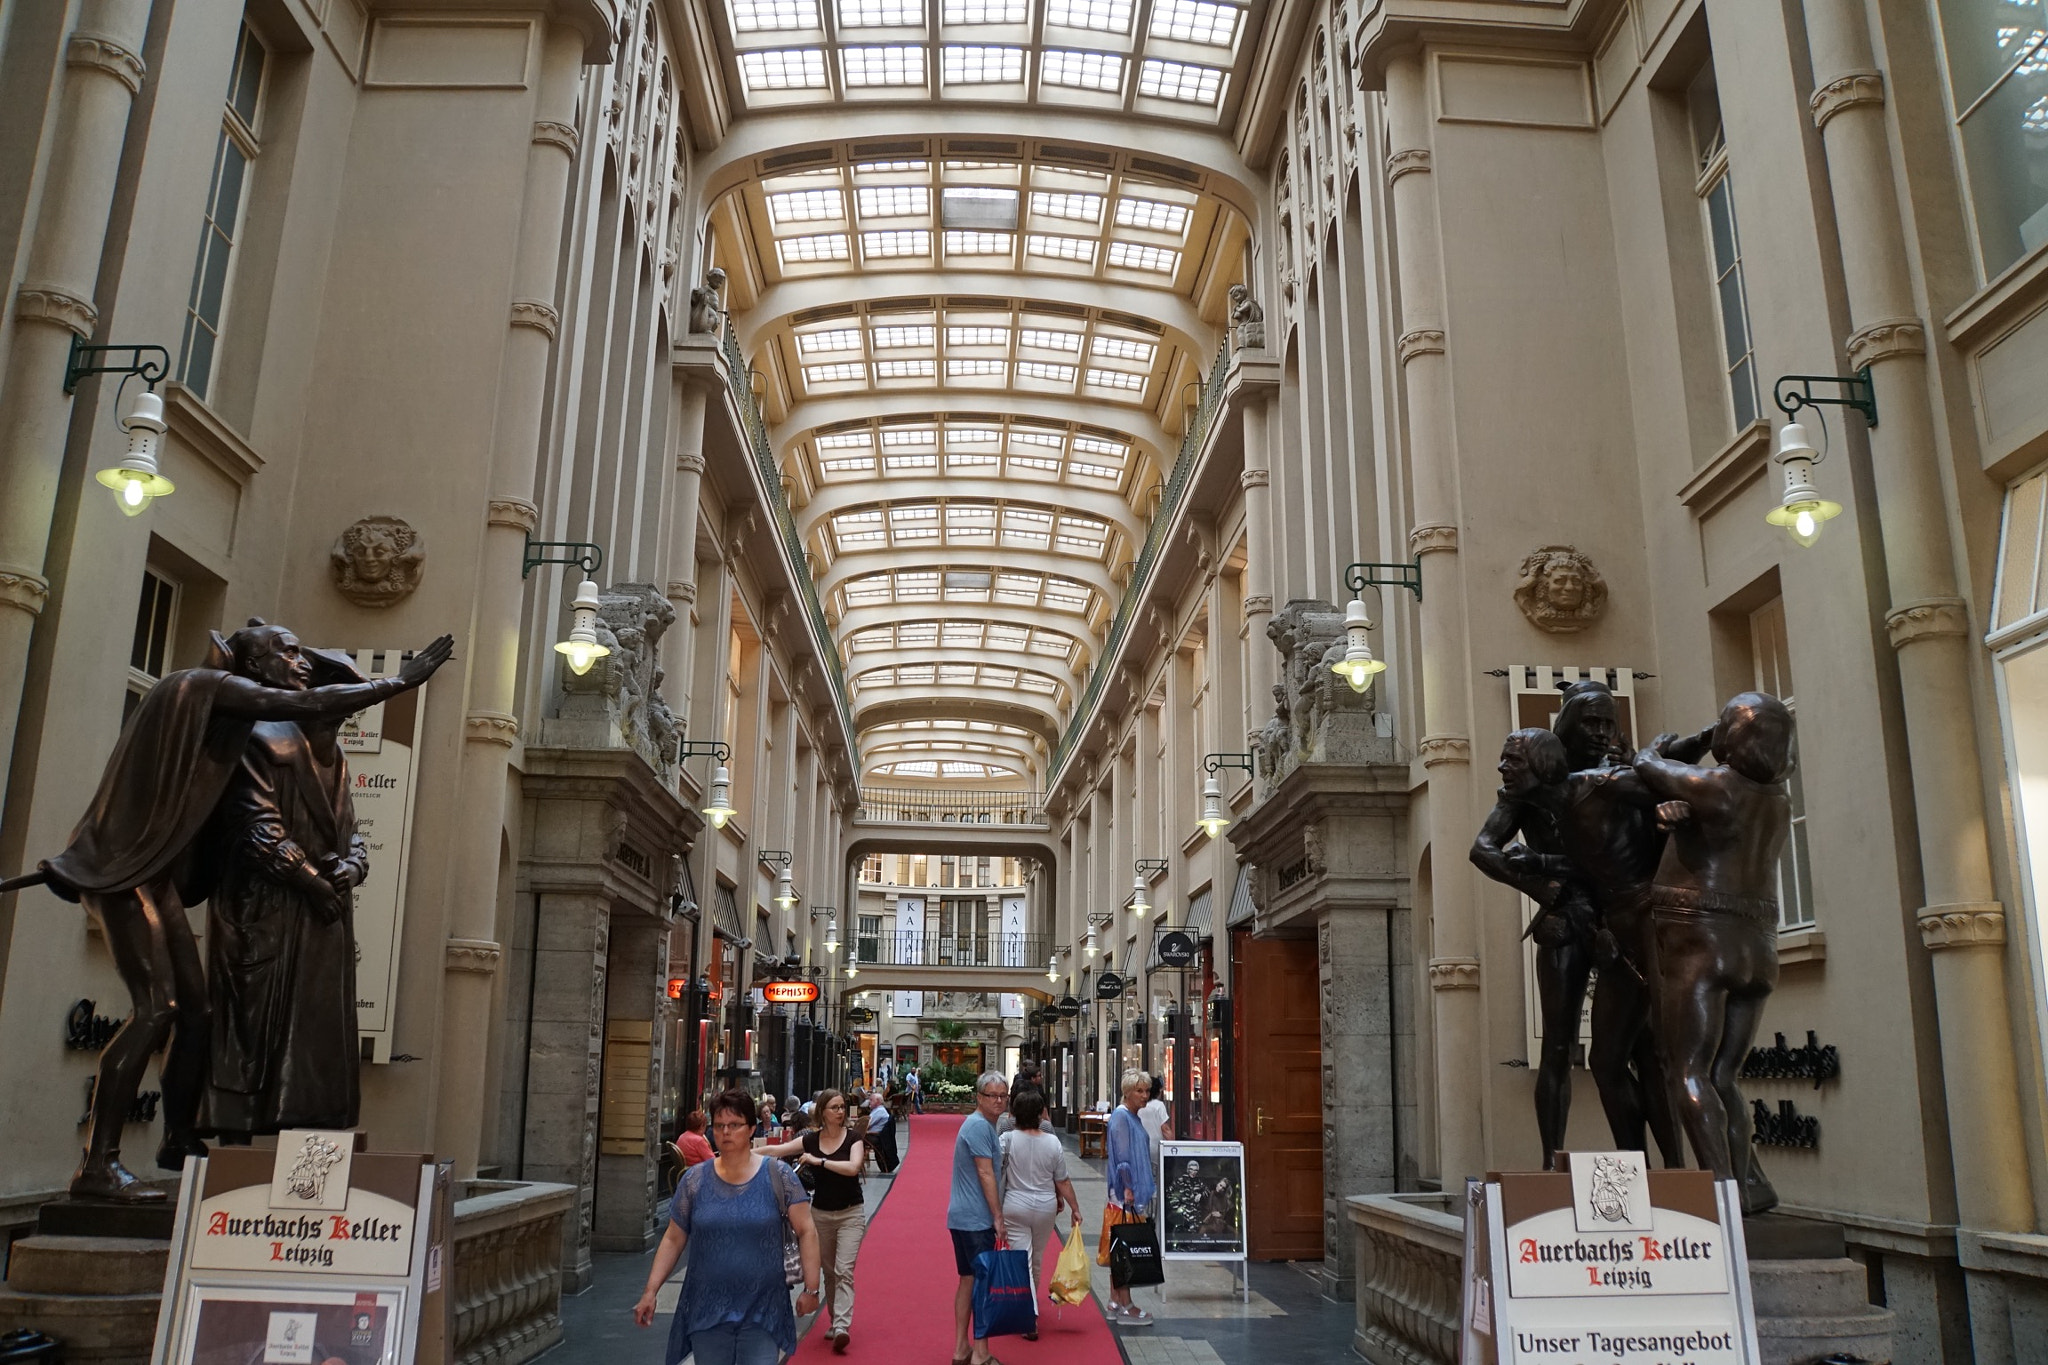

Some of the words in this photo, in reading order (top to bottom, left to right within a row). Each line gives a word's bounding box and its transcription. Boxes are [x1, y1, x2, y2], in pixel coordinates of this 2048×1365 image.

[343, 738, 364, 746] Leipzig
[354, 773, 397, 789] Keller
[768, 987, 814, 997] MEPHISTO
[207, 1211, 324, 1242] Auerbachs
[328, 1215, 402, 1242] Keller
[270, 1241, 334, 1267] Leipzig
[1519, 1237, 1634, 1265] Auerbachs
[1638, 1236, 1712, 1262] Keller
[1586, 1266, 1652, 1290] Leipzig
[1517, 1332, 1581, 1354] Unser
[1587, 1330, 1733, 1357] Tagesangebot
